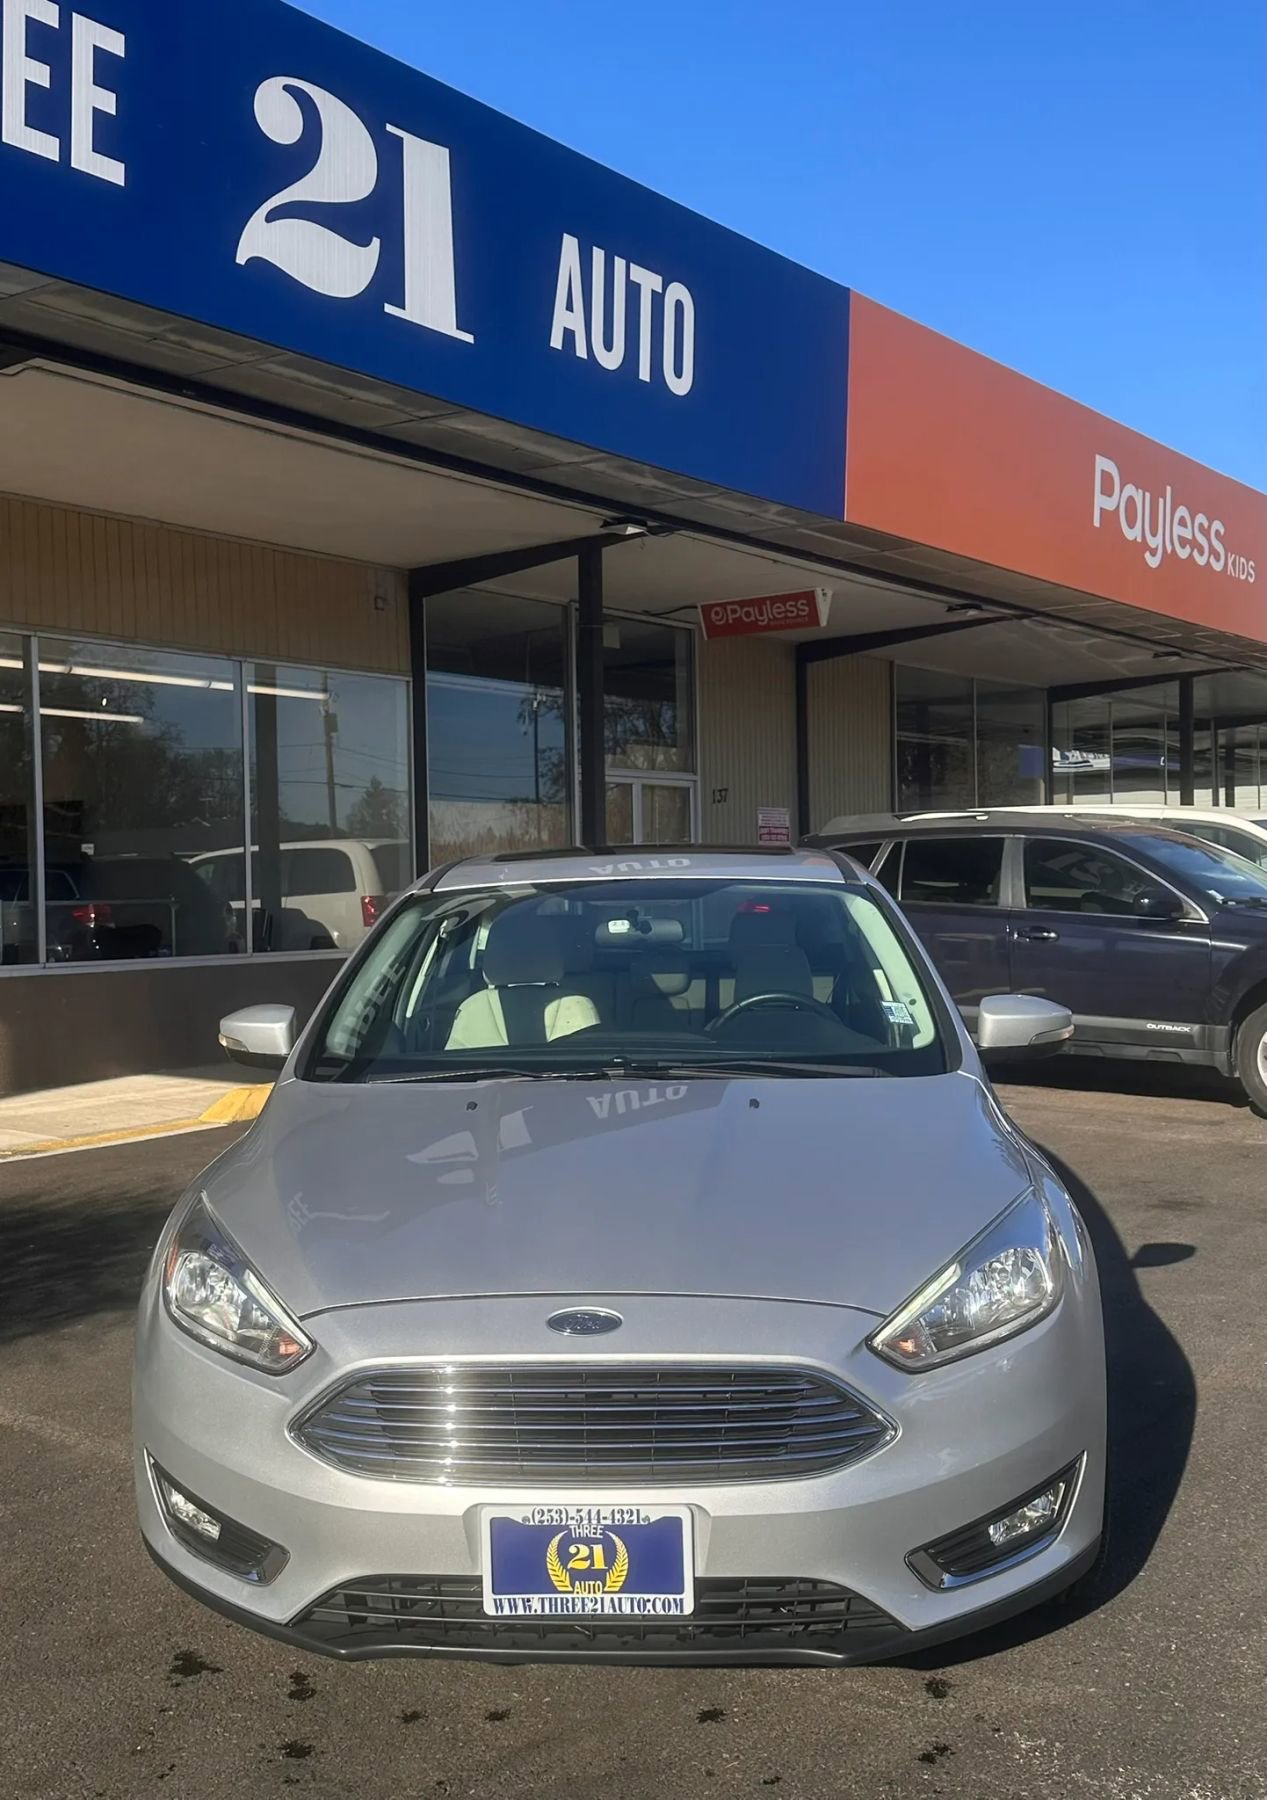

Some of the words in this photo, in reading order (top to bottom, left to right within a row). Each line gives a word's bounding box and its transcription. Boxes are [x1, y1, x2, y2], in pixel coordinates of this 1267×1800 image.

[235, 76, 475, 344] 21
[549, 232, 695, 397] AUTO
[1093, 453, 1226, 572] Payless
[1227, 552, 1256, 583] KIDS
[726, 599, 809, 625] Payless
[712, 787, 728, 804] 137
[1146, 1023, 1191, 1032] OUTBACK
[531, 1506, 640, 1526] (253)-544-4321
[568, 1525, 605, 1539] THREE
[566, 1543, 608, 1570] 21
[573, 1580, 603, 1595] AUTO
[492, 1596, 685, 1615] WWW.THREE21AUTO.COM
